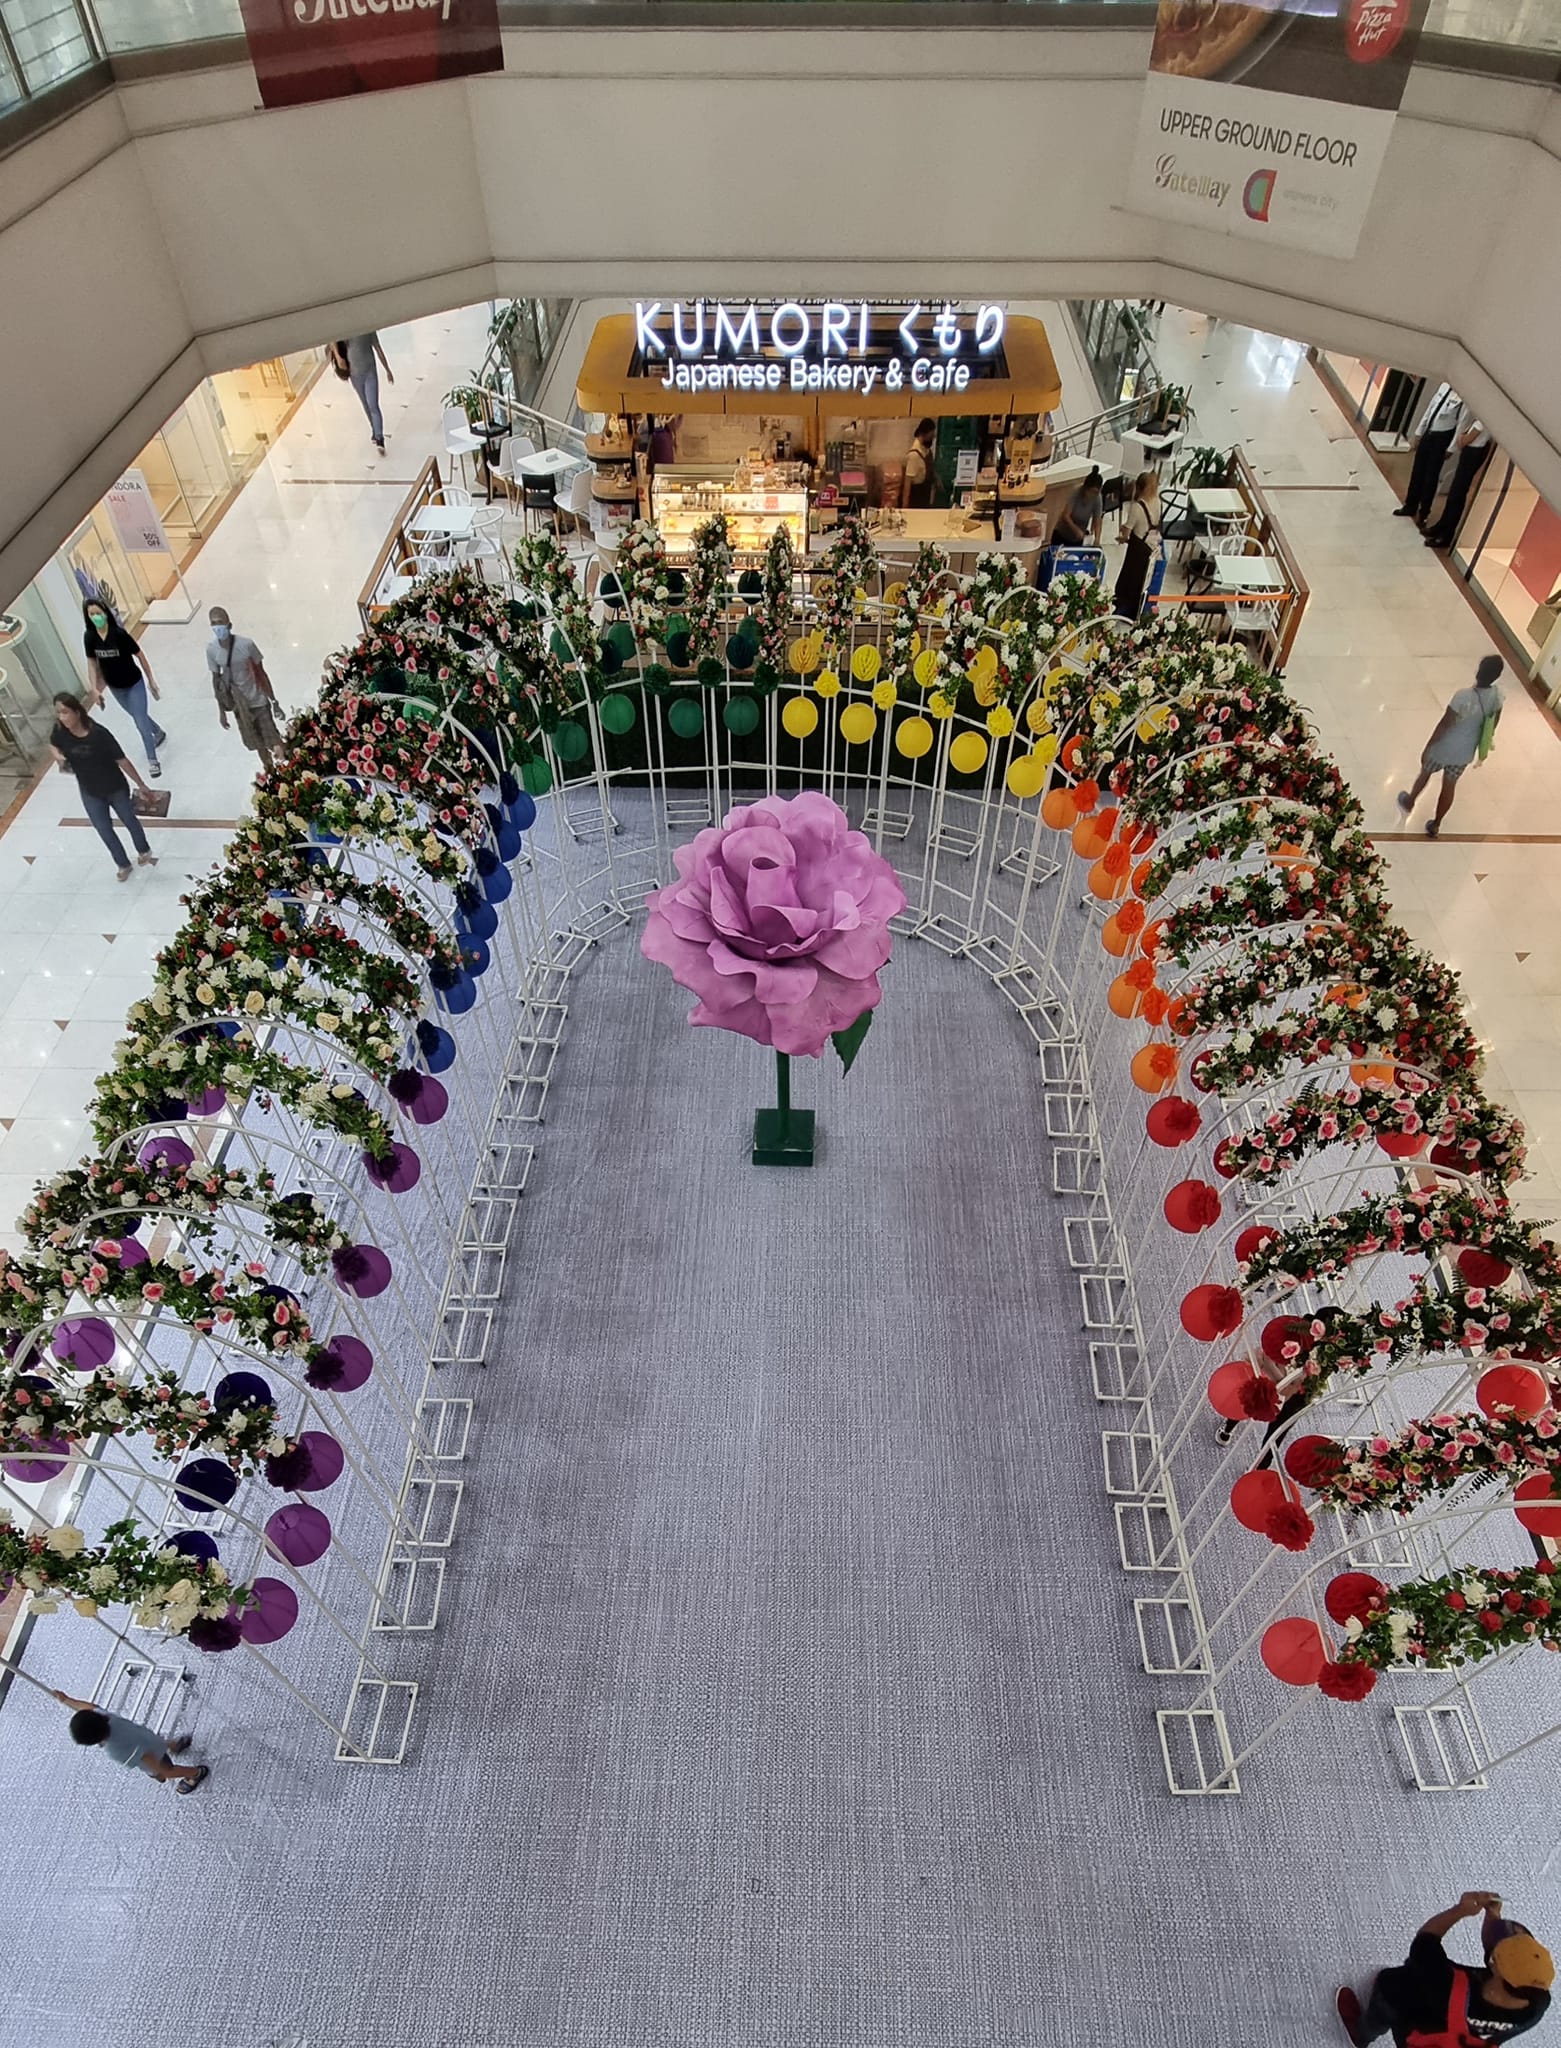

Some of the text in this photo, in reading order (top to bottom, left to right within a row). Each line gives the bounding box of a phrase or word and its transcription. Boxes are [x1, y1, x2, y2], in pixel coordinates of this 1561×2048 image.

[1354, 8, 1393, 32] Pizza
[1357, 26, 1387, 47] Hut
[1160, 107, 1358, 168] UPPER GROUND FLOOR
[634, 301, 868, 355] KUMORI
[898, 302, 1006, 354] くもり
[661, 357, 971, 393] Japanese Bakery & Cafe
